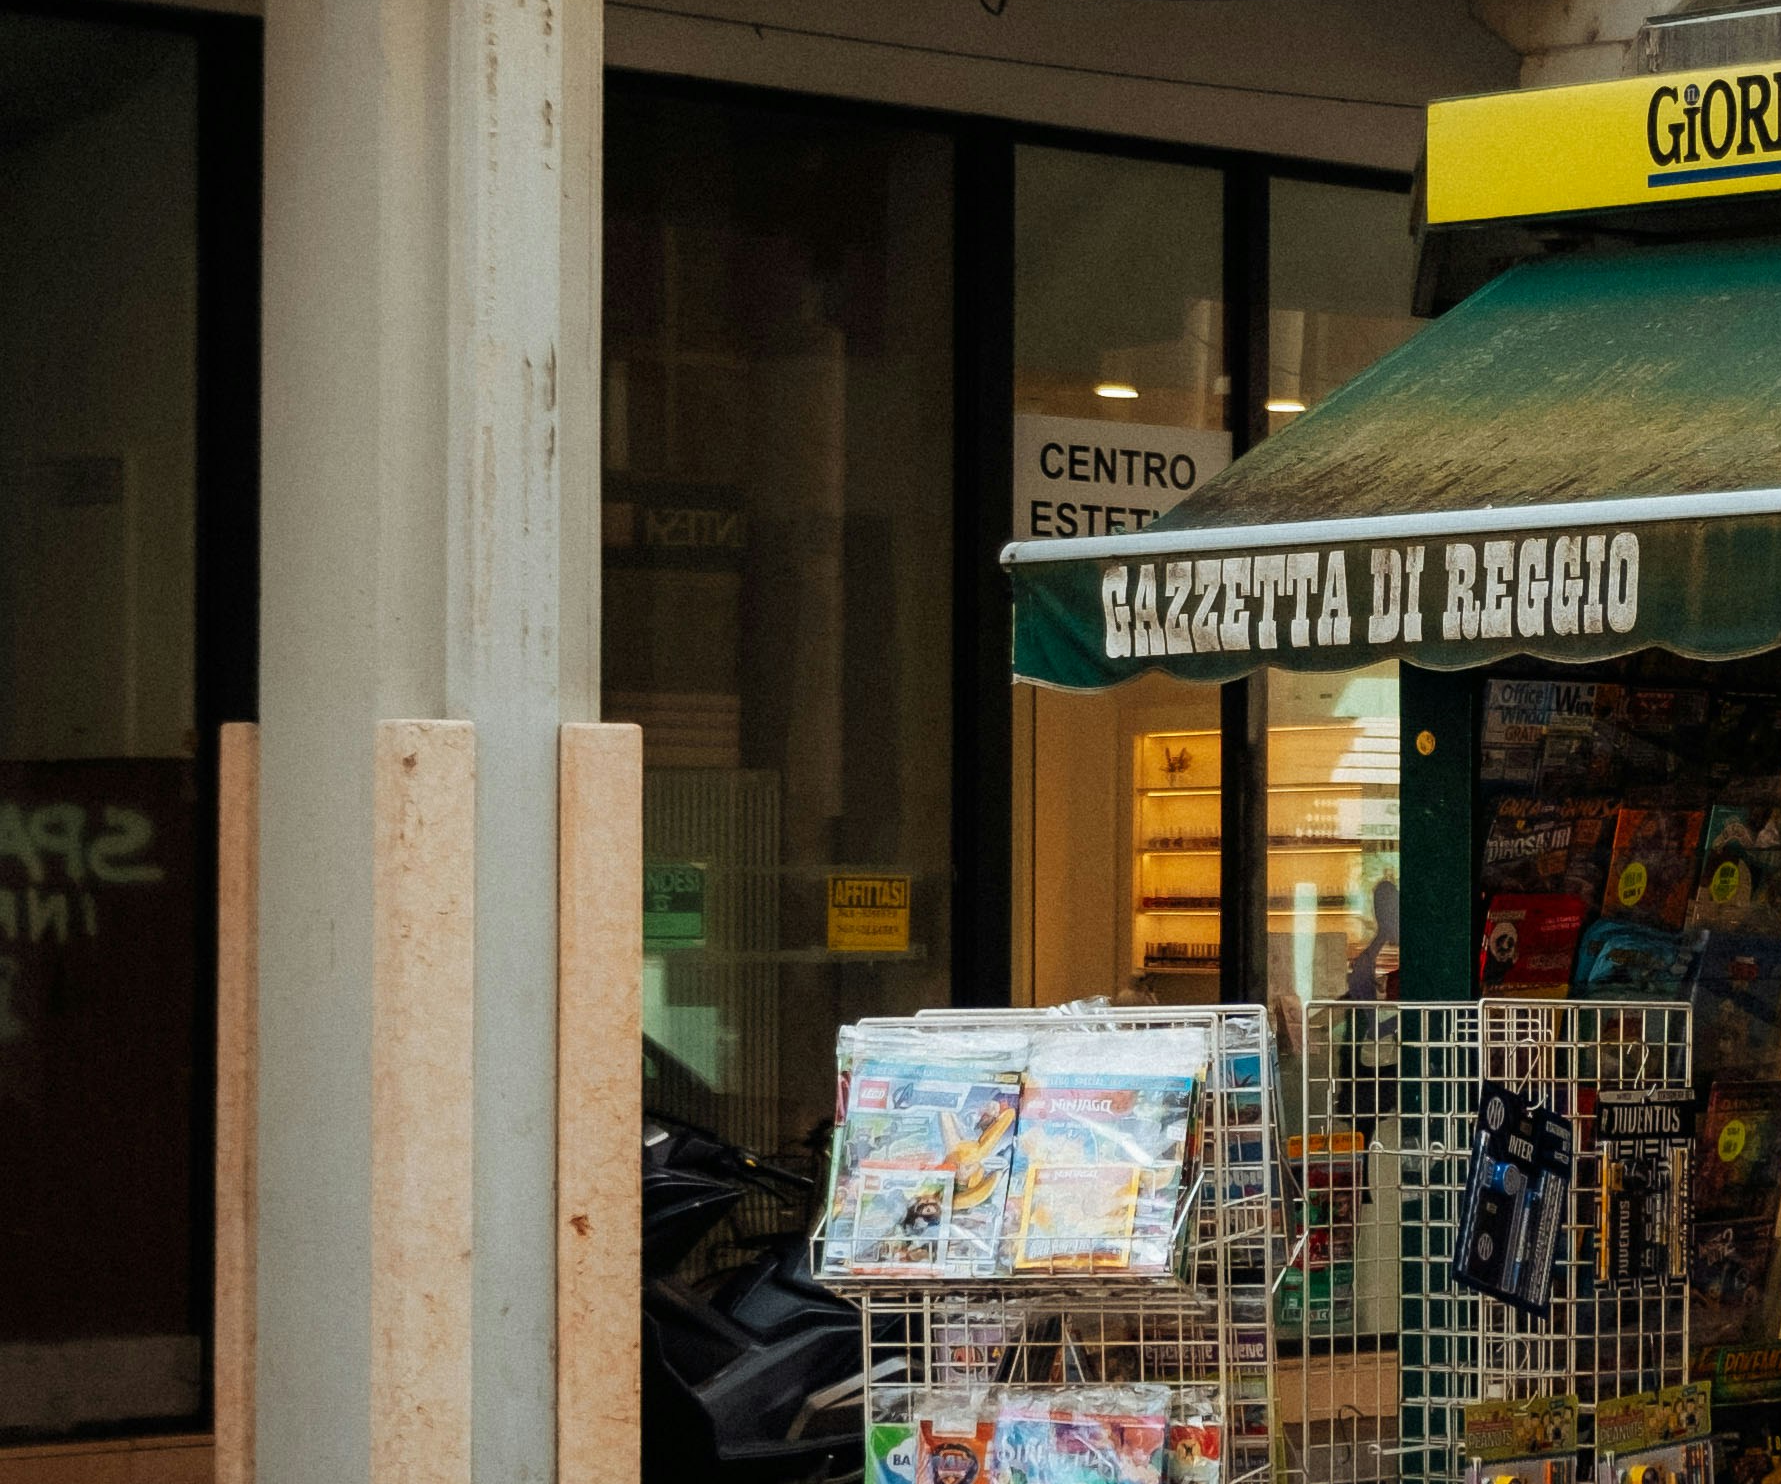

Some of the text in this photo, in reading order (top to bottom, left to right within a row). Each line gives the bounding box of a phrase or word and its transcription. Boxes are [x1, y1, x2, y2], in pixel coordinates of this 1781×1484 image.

[1040, 442, 1196, 491] CENTRO
[1031, 500, 1160, 538] ESTET
[1102, 532, 1641, 658] GAZZETTA DI REGGIO
[1051, 1098, 1112, 1114] NINJAGO
[1611, 1105, 1681, 1135] JUVENTUS
[1507, 1133, 1535, 1164] INTER
[1618, 1199, 1632, 1277] JUVENTUS
[1468, 1430, 1514, 1449] PEANUTS
[1599, 1423, 1644, 1443] PEANUTS
